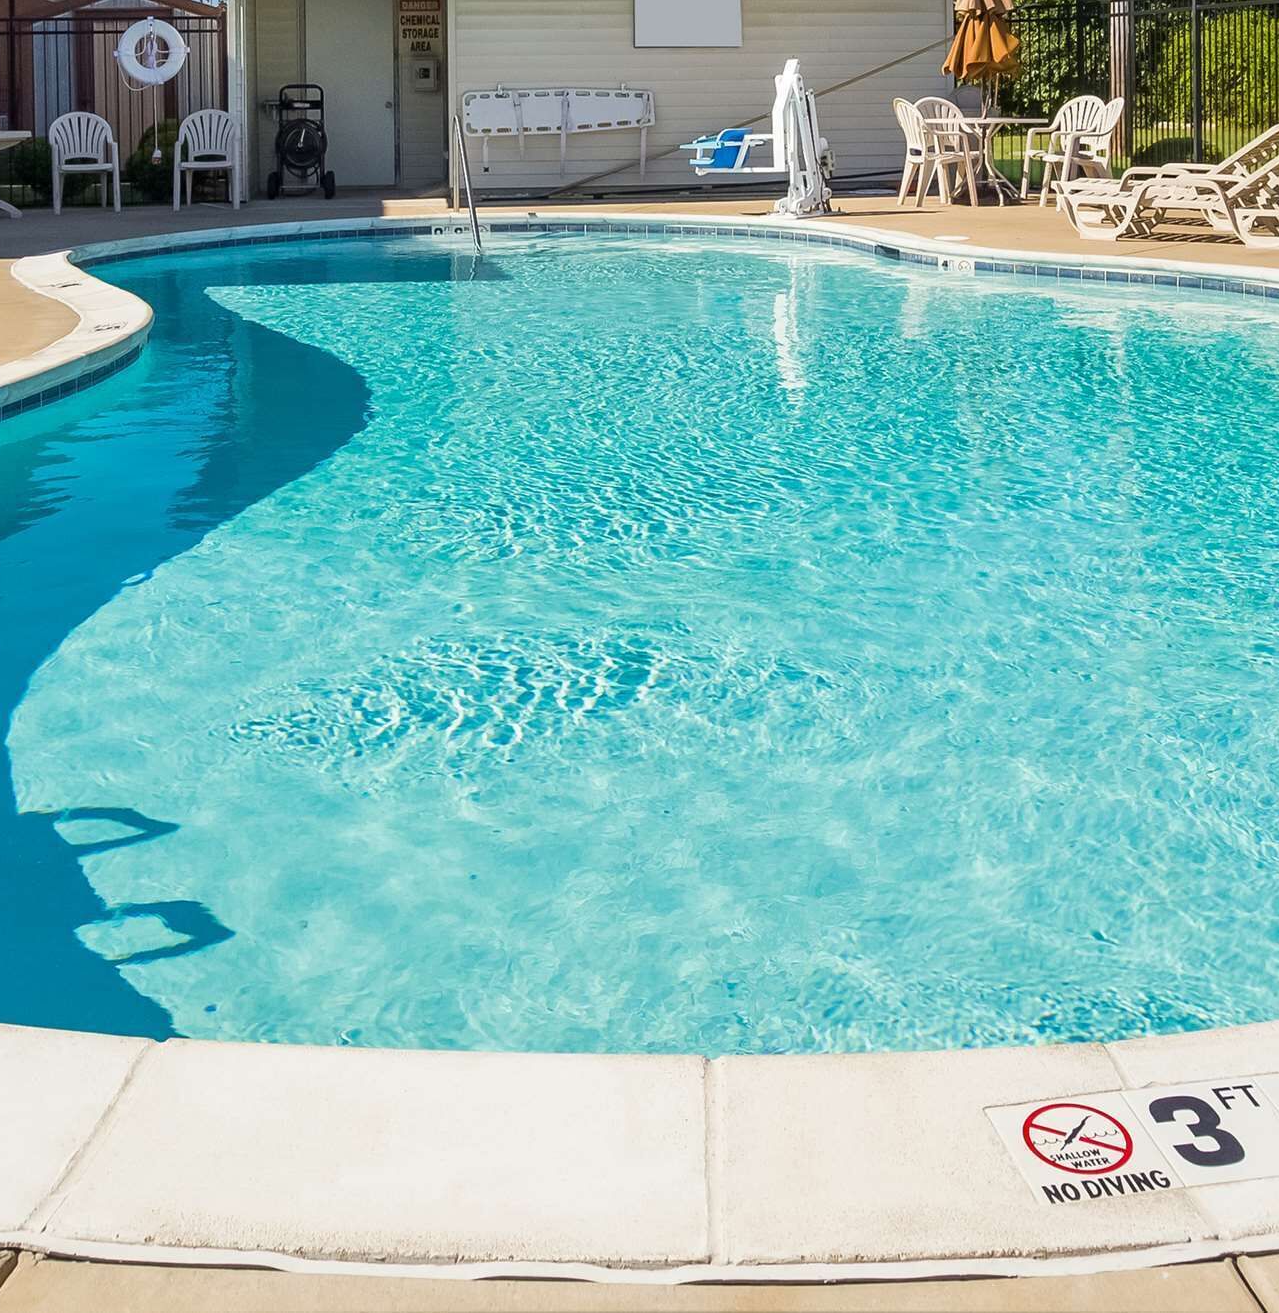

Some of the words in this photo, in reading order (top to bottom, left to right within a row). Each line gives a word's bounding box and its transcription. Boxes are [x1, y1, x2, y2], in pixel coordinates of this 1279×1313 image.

[400, 15, 440, 25] CHEMICAL
[402, 28, 439, 38] STORAGE
[410, 41, 431, 51] AREA
[1148, 1095, 1245, 1167] 3
[1211, 1084, 1260, 1110] FT
[1050, 1148, 1102, 1163] SHALLOW
[1070, 1157, 1111, 1170] WATER
[1041, 1182, 1081, 1204] NO
[1080, 1170, 1171, 1199] DIVING
